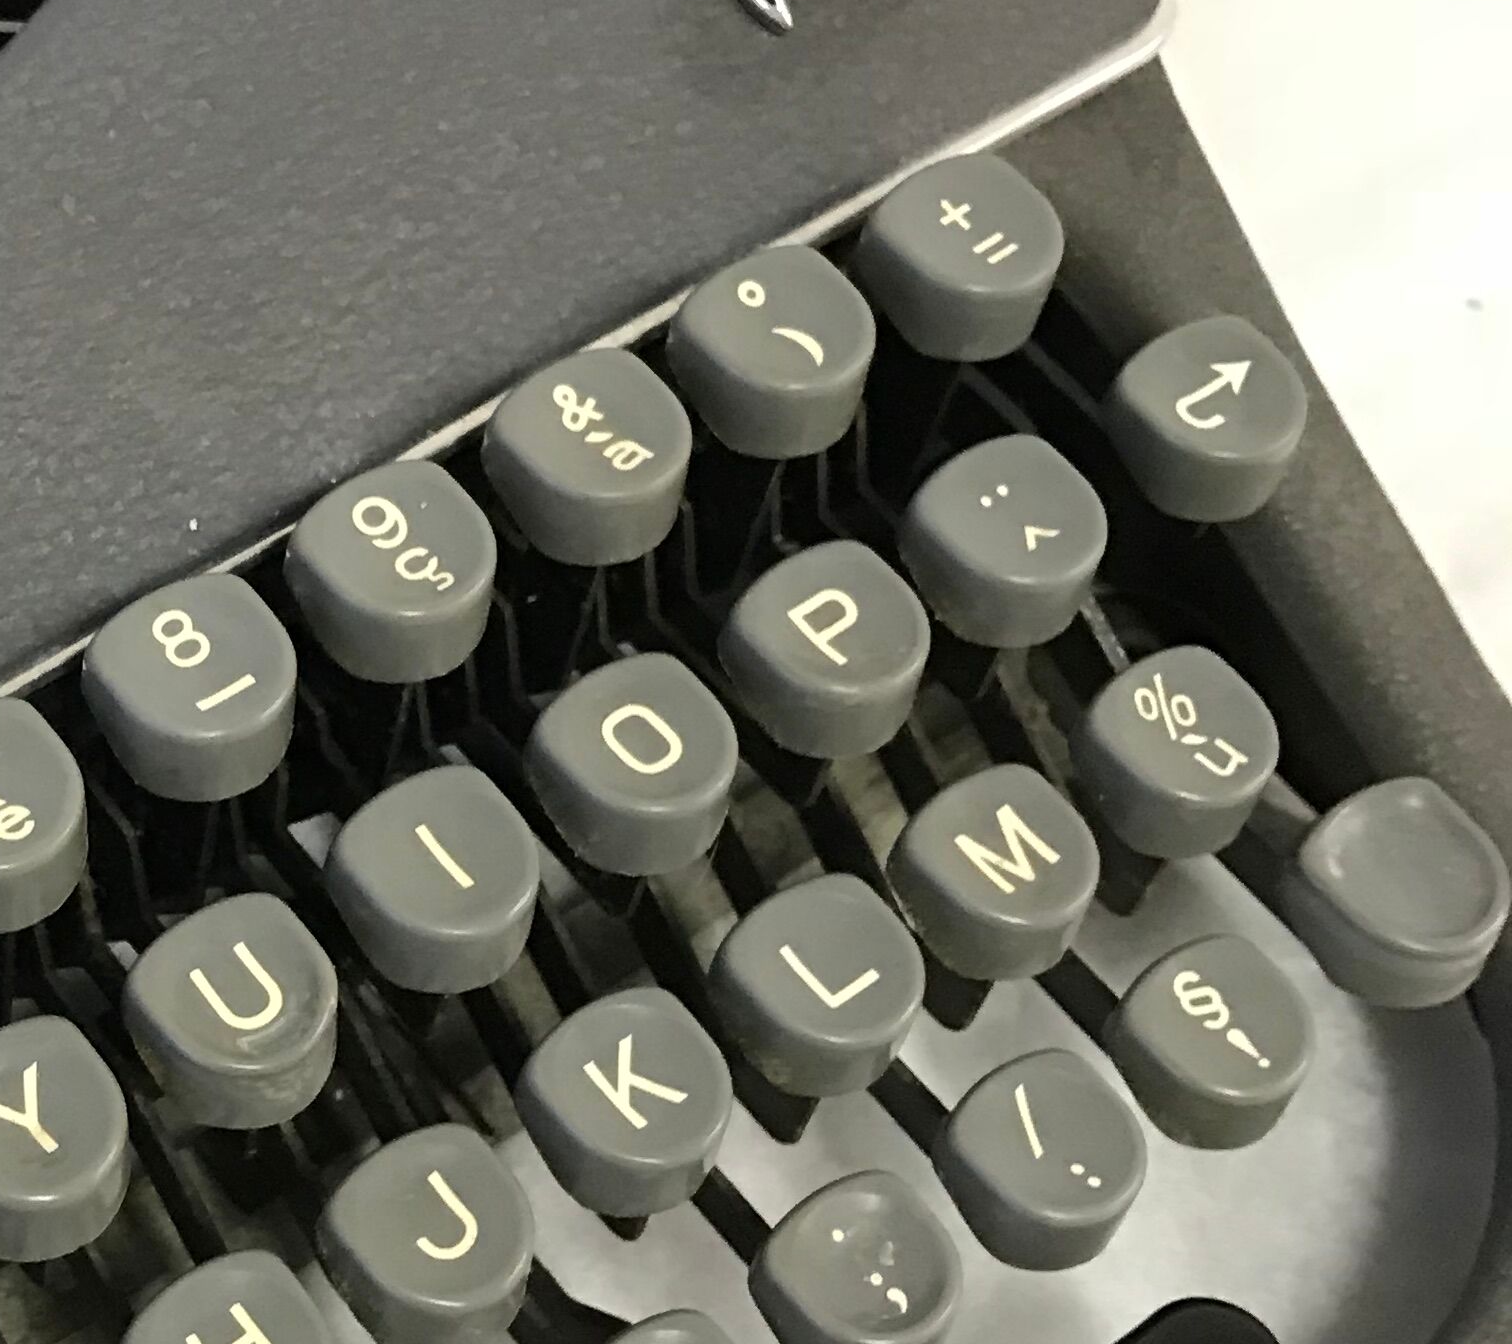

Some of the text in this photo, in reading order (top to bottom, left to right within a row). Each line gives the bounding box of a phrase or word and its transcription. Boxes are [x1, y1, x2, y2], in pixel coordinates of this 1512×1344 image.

[552, 384, 604, 433] &
[351, 496, 408, 549] 9
[394, 546, 455, 591] ç
[151, 609, 211, 668] 8
[787, 589, 859, 666] P
[601, 703, 683, 774] O
[1134, 672, 1197, 741] %
[414, 824, 475, 889] I
[954, 804, 1061, 894] M
[189, 941, 283, 1030] U
[779, 945, 880, 1009] L
[582, 1033, 689, 1130] K
[1226, 1028, 1271, 1068] !
[416, 1170, 478, 1260] J
